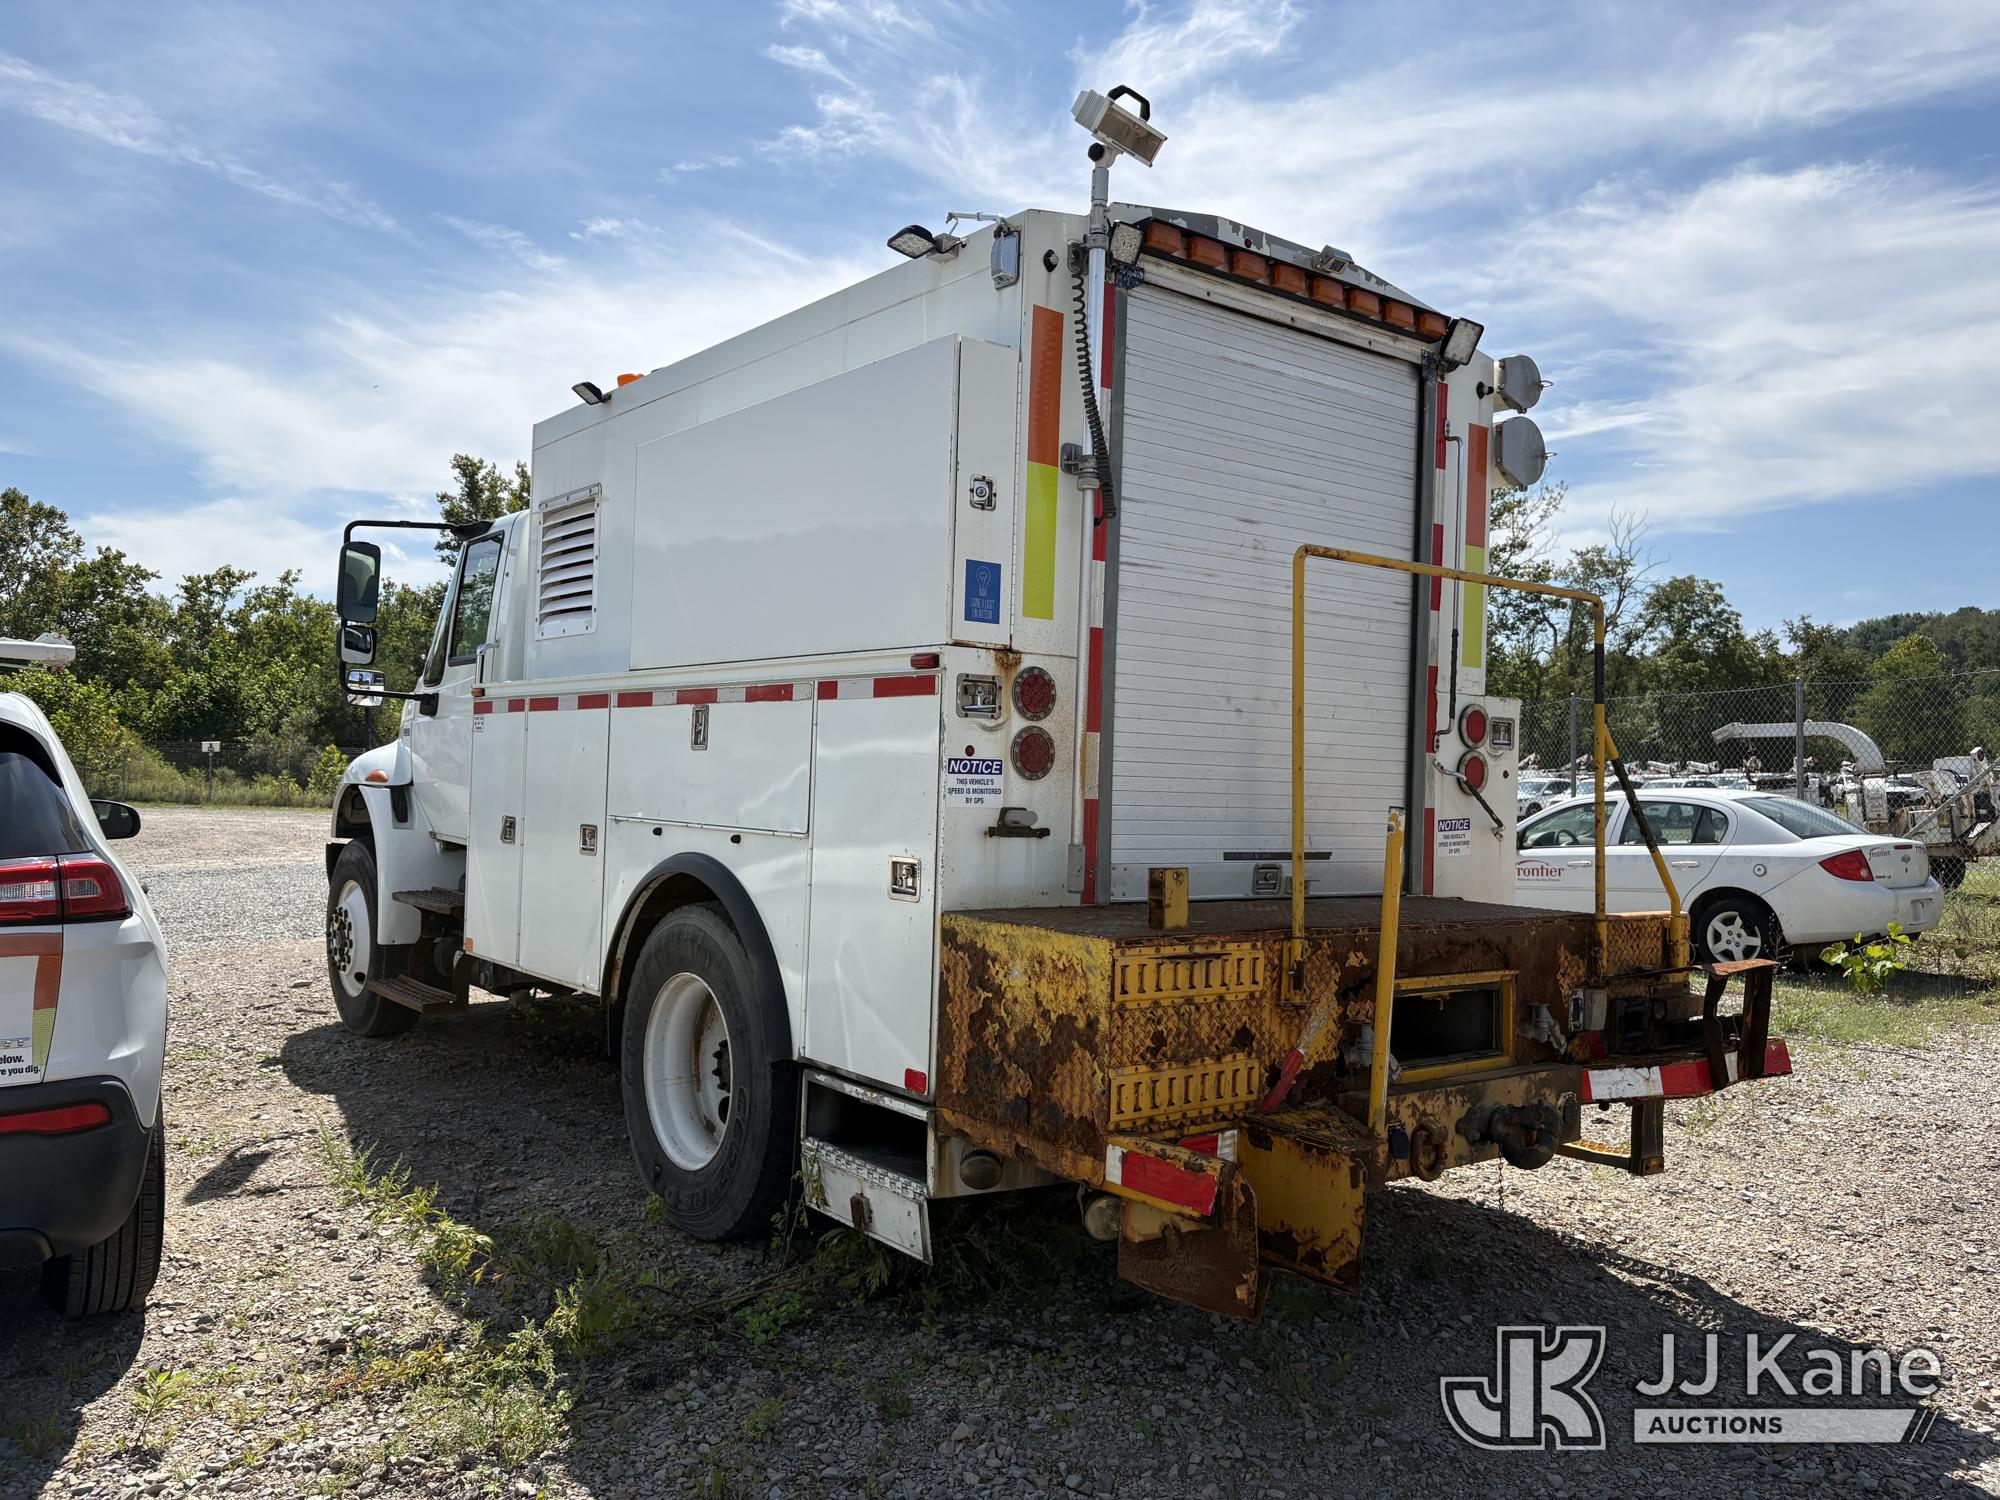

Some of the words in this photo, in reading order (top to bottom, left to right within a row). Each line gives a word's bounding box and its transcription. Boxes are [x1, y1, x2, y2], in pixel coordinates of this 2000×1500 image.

[948, 760, 1002, 774] NOTICE
[948, 787, 964, 795] SPEED
[1438, 819, 1469, 831] NOTICE
[8, 1067, 24, 1076] you
[25, 1065, 41, 1074] dig.
